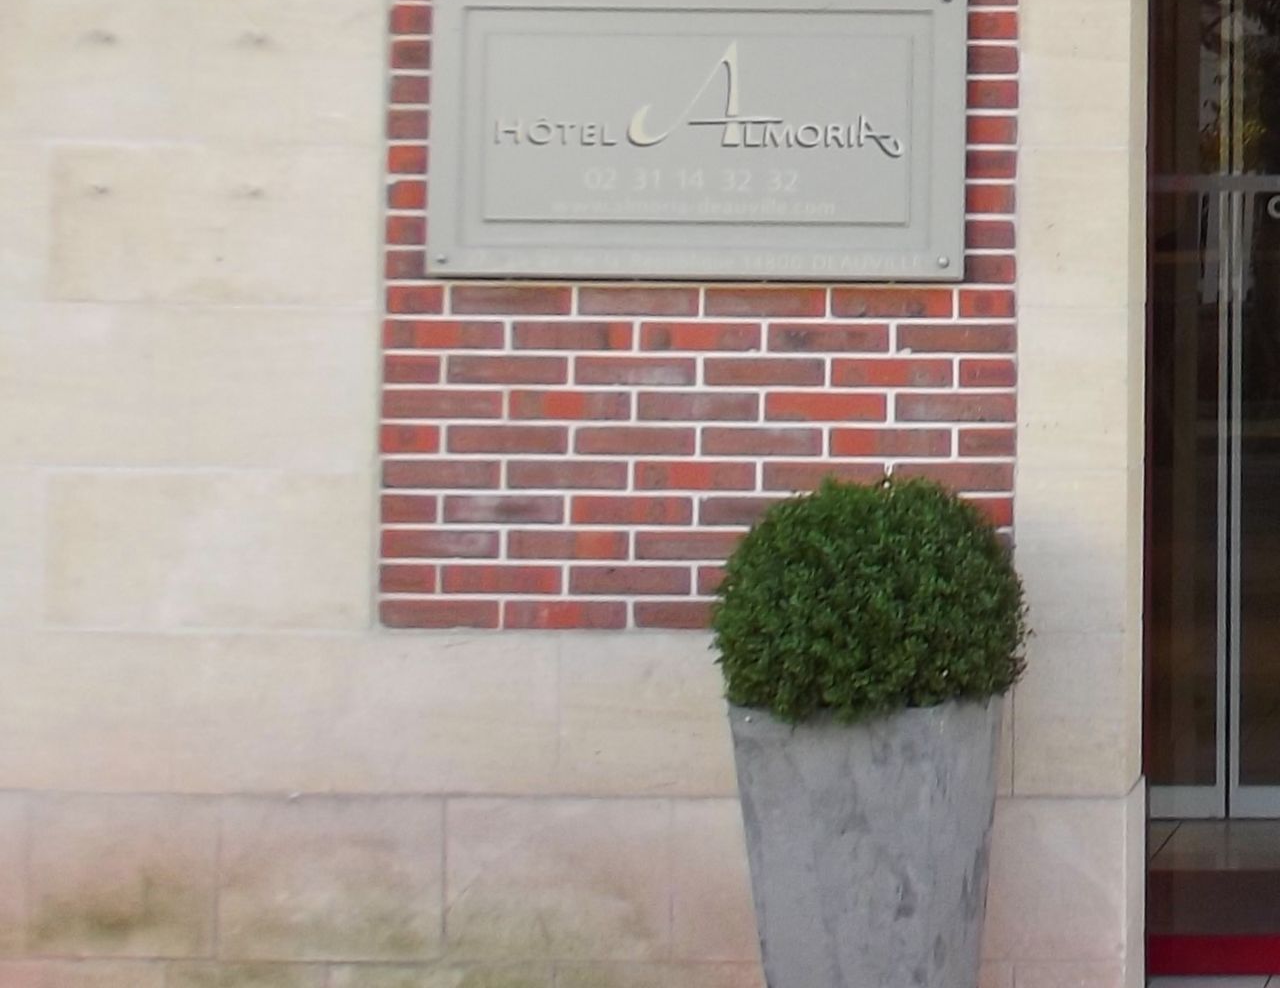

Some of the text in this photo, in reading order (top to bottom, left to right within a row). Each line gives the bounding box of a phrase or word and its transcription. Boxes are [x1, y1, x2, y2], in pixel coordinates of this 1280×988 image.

[493, 39, 905, 159] HÔTEL ALMORIA
[585, 167, 799, 193] 02 31 14 32 32
